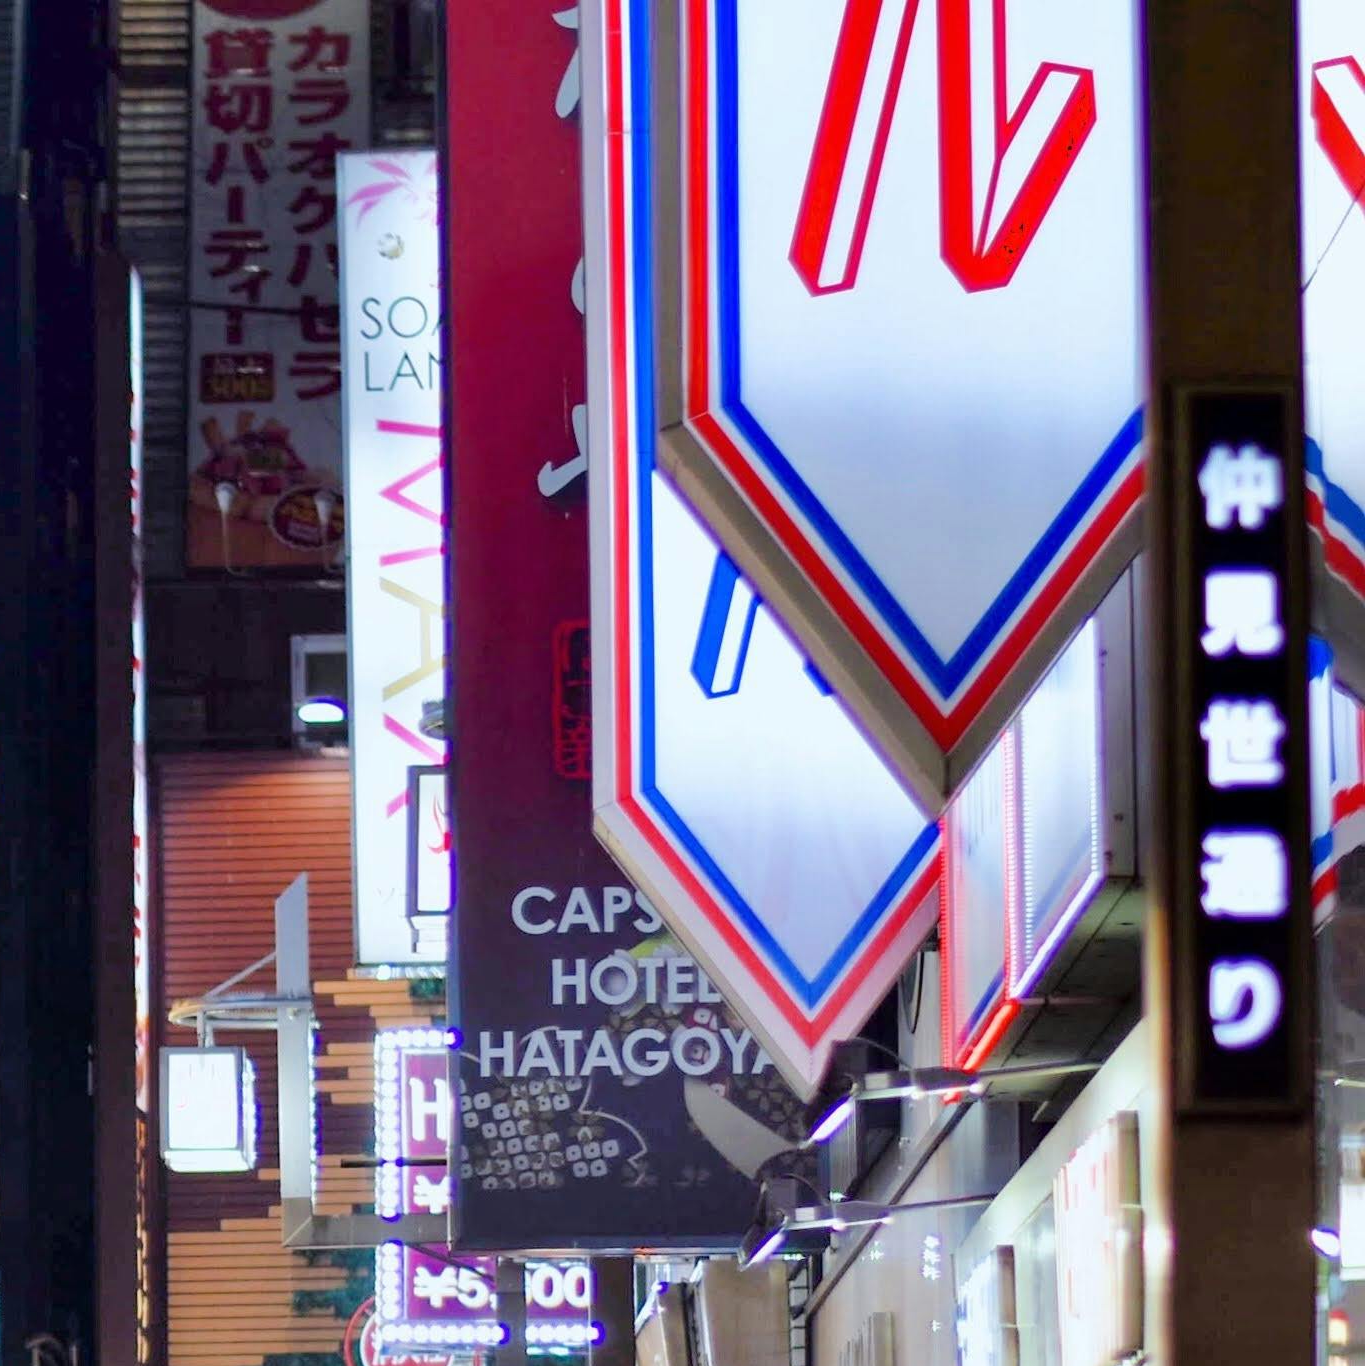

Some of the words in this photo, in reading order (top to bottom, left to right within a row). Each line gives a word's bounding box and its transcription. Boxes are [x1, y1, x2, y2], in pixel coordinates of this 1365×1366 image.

[1199, 443, 1285, 1050] 仲見世通り
